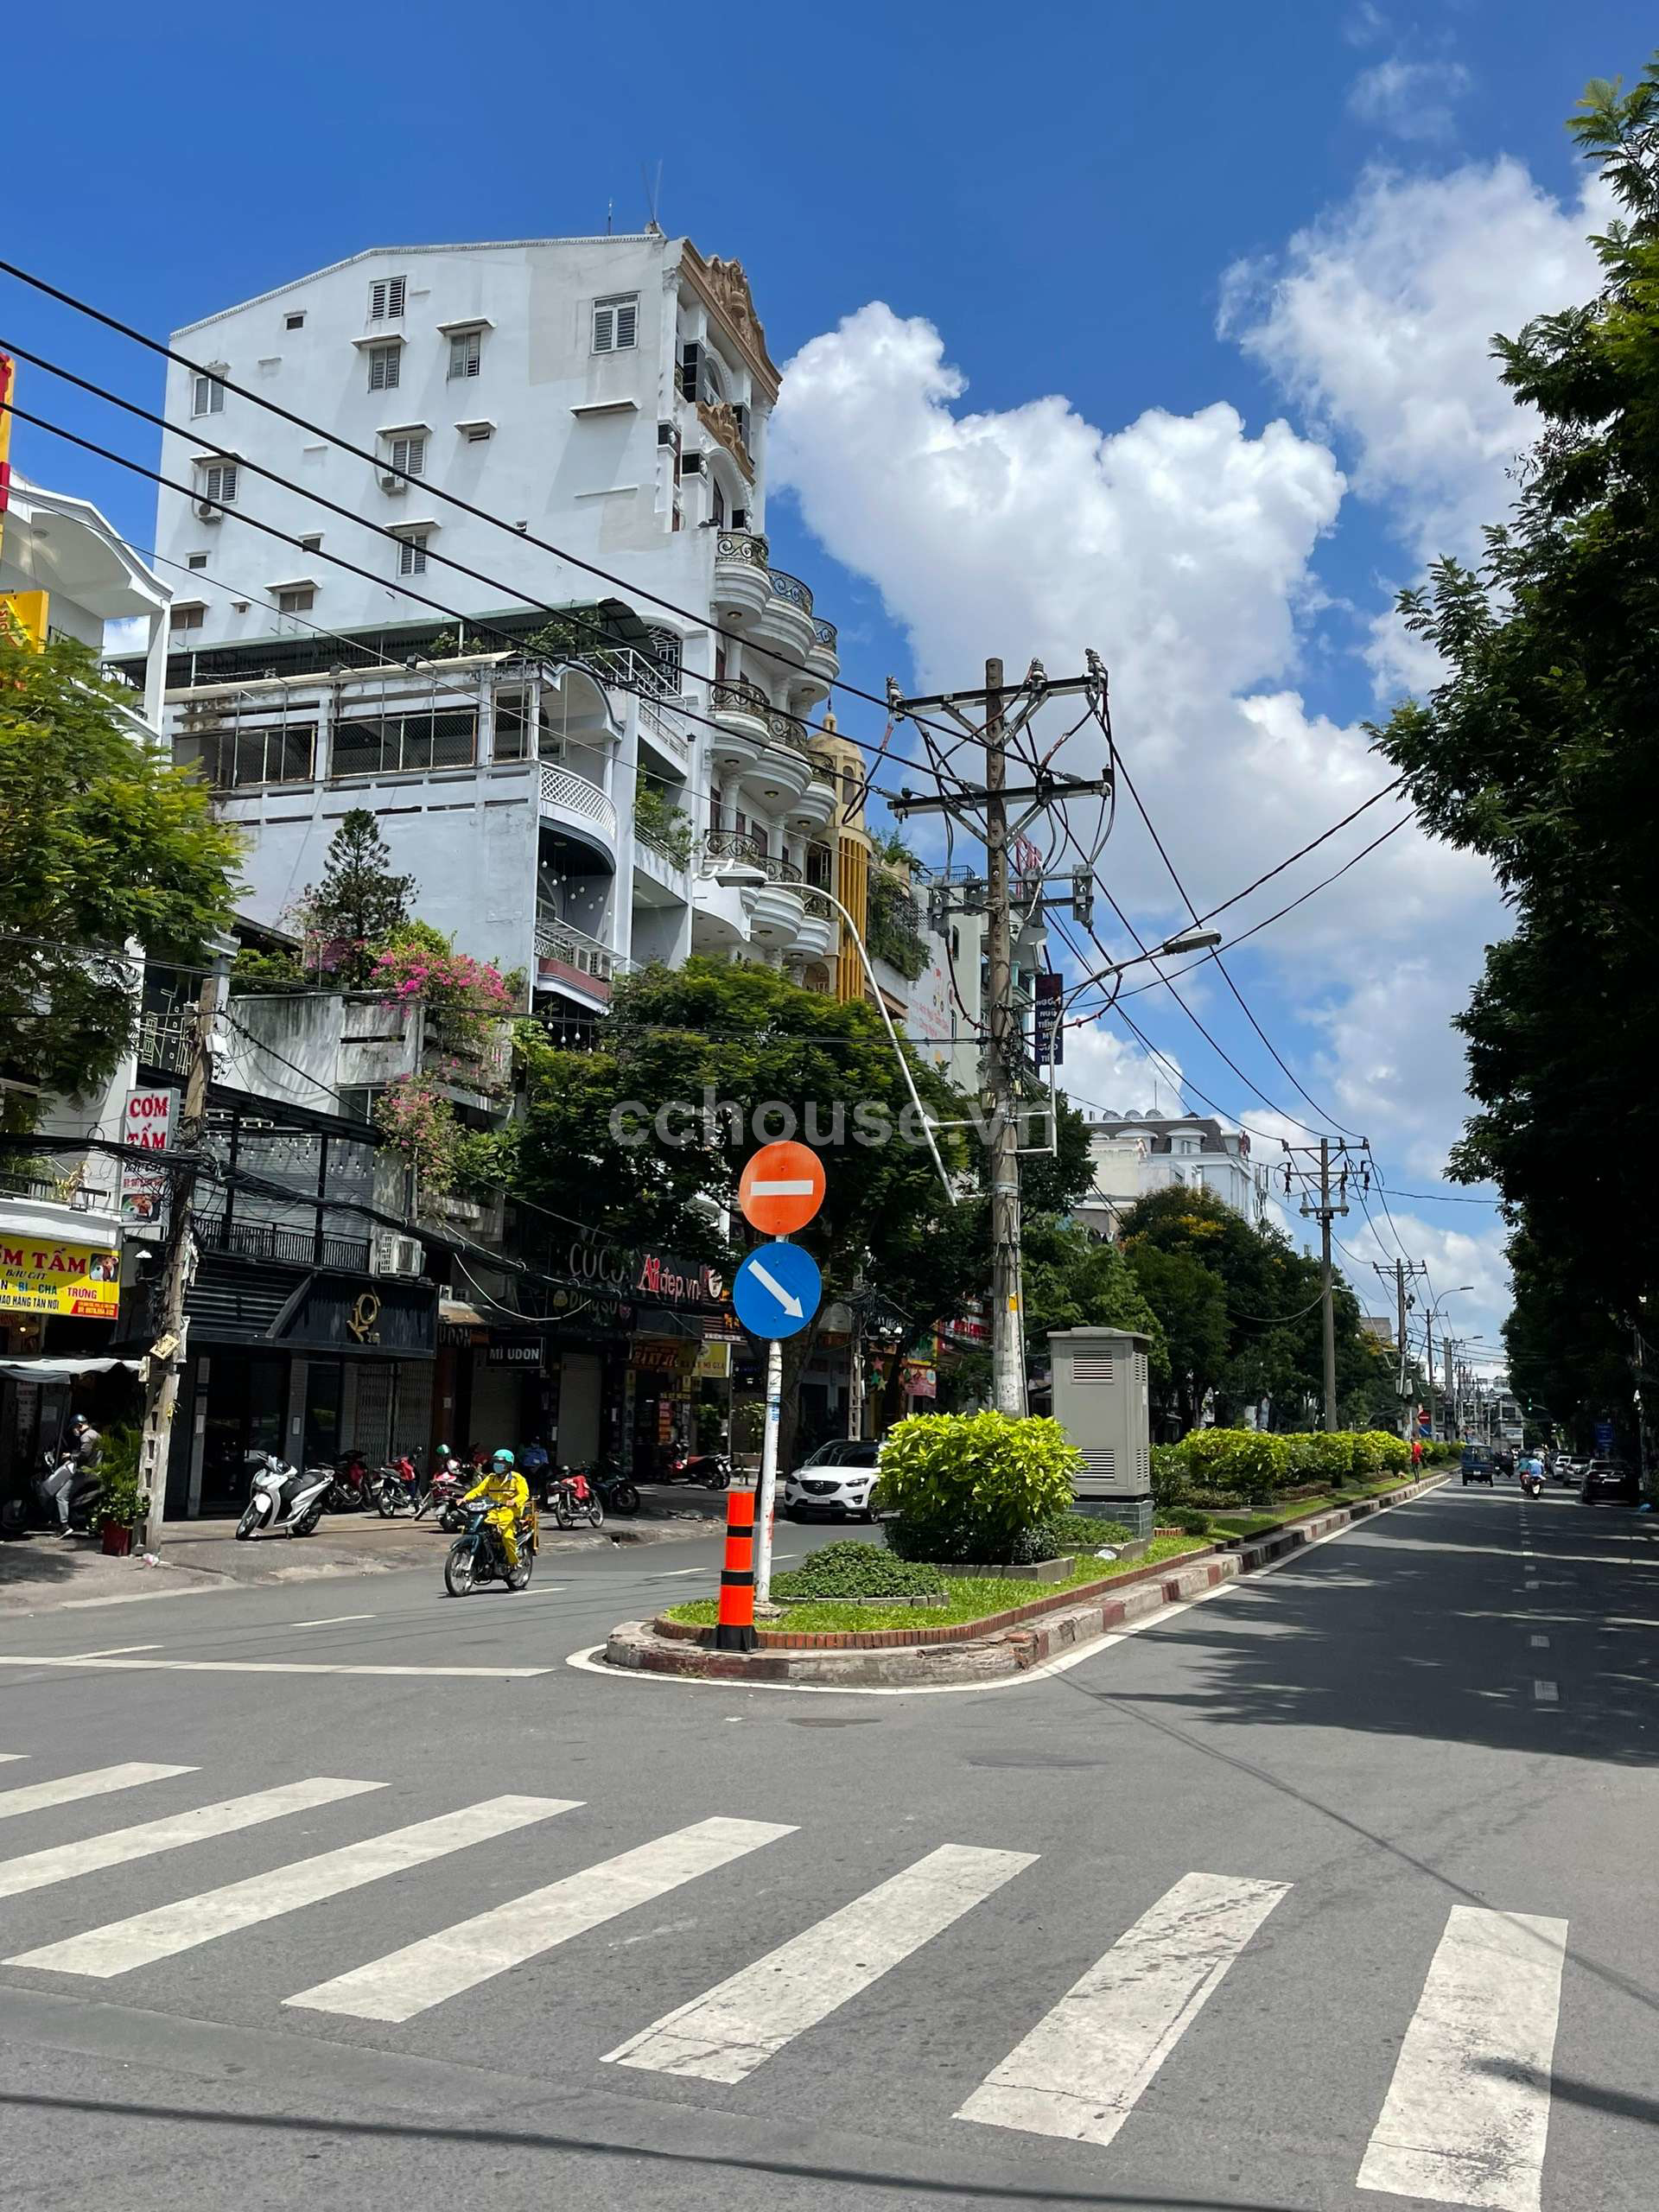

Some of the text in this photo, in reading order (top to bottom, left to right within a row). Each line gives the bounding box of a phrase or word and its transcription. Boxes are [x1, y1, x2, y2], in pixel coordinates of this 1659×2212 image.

[130, 1093, 168, 1117] CƠM
[32, 1249, 86, 1274] TẤM
[507, 1348, 539, 1360] UDON
